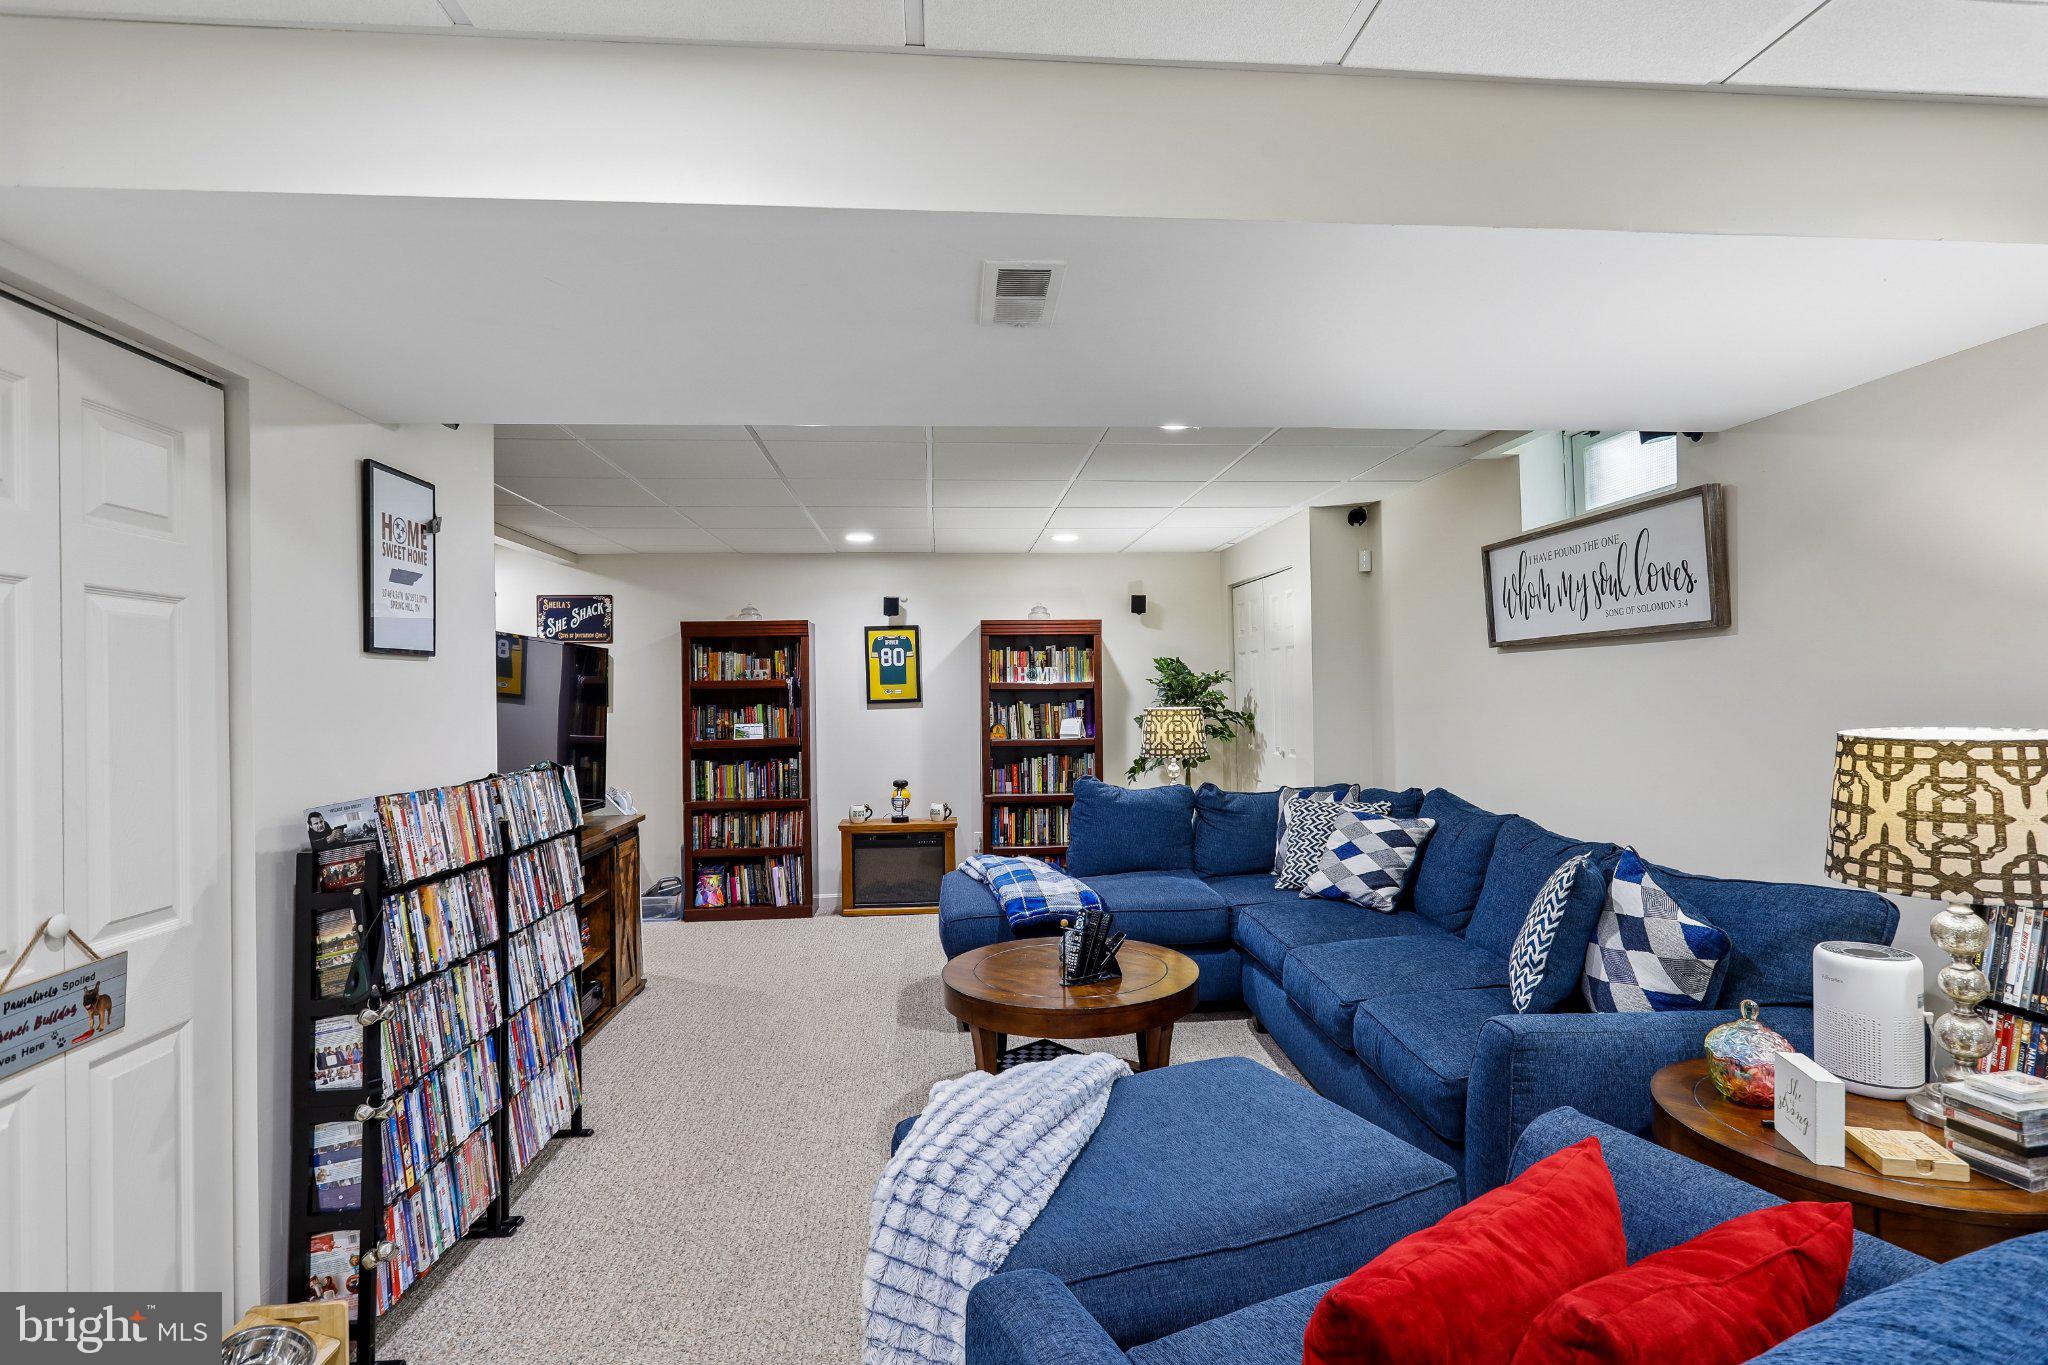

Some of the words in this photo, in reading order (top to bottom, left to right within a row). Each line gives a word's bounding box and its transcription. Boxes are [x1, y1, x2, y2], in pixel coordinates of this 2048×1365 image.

[382, 512, 428, 551] HOME
[382, 542, 407, 561] SWEET
[407, 548, 428, 566] HOME
[1529, 554, 1533, 566] I
[1533, 550, 1553, 564] HAVE
[1554, 544, 1581, 561] FOUND
[1583, 538, 1600, 552] THE
[1601, 533, 1620, 548] ONE
[1502, 550, 1556, 621] whom
[1557, 569, 1589, 622] my
[1592, 541, 1631, 610] soul
[546, 616, 568, 638] SHE
[570, 602, 604, 628] SHACK
[1605, 607, 1625, 618] SONG
[1625, 605, 1636, 616] OF
[1636, 600, 1676, 614] SOLOMON
[1677, 598, 1689, 609] 3:4
[880, 647, 905, 667] 80
[33, 1004, 79, 1032] Bulldog
[21, 1042, 46, 1058] Here
[2026, 1047, 2037, 1067] MAN
